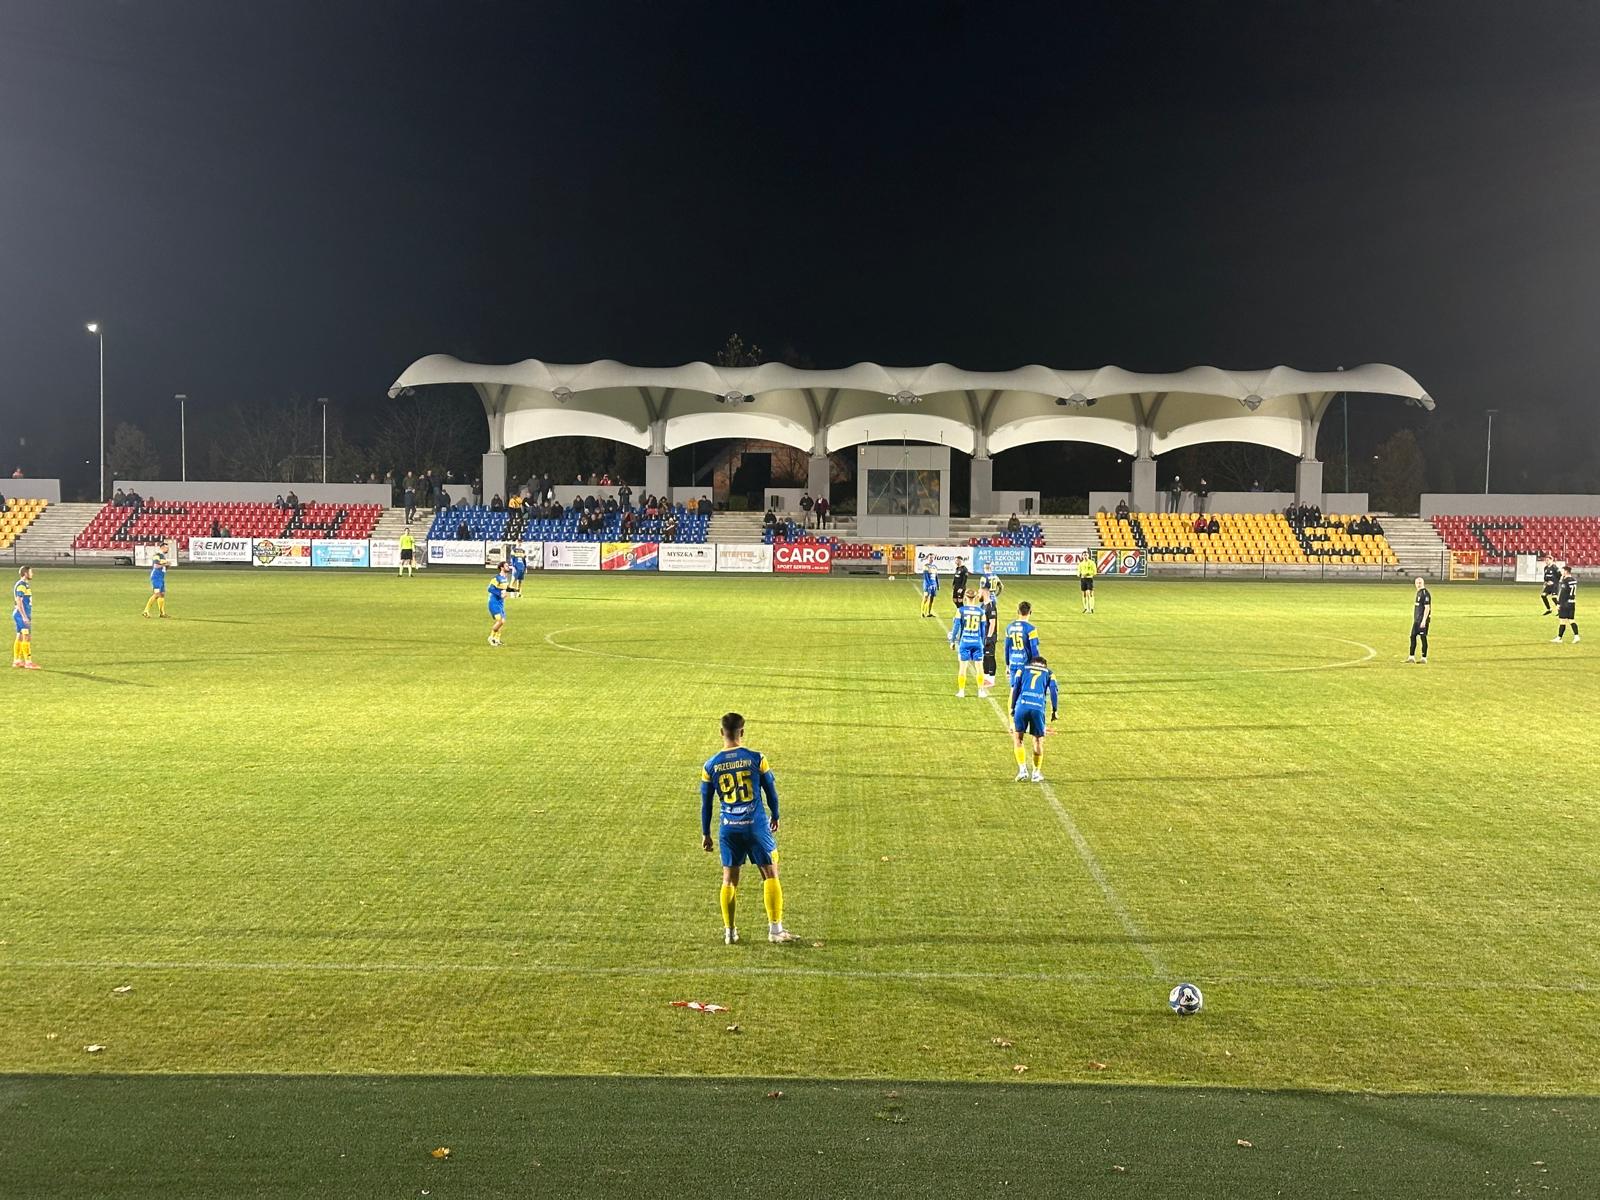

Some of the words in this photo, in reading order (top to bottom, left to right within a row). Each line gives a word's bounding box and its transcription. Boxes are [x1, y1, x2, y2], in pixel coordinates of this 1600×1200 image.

[776, 547, 830, 563] CARO
[964, 614, 980, 631] 16
[1010, 631, 1025, 651] 15
[1030, 669, 1042, 690] 7
[714, 759, 752, 772] PRZEWOŹNY
[719, 771, 754, 804] 95
